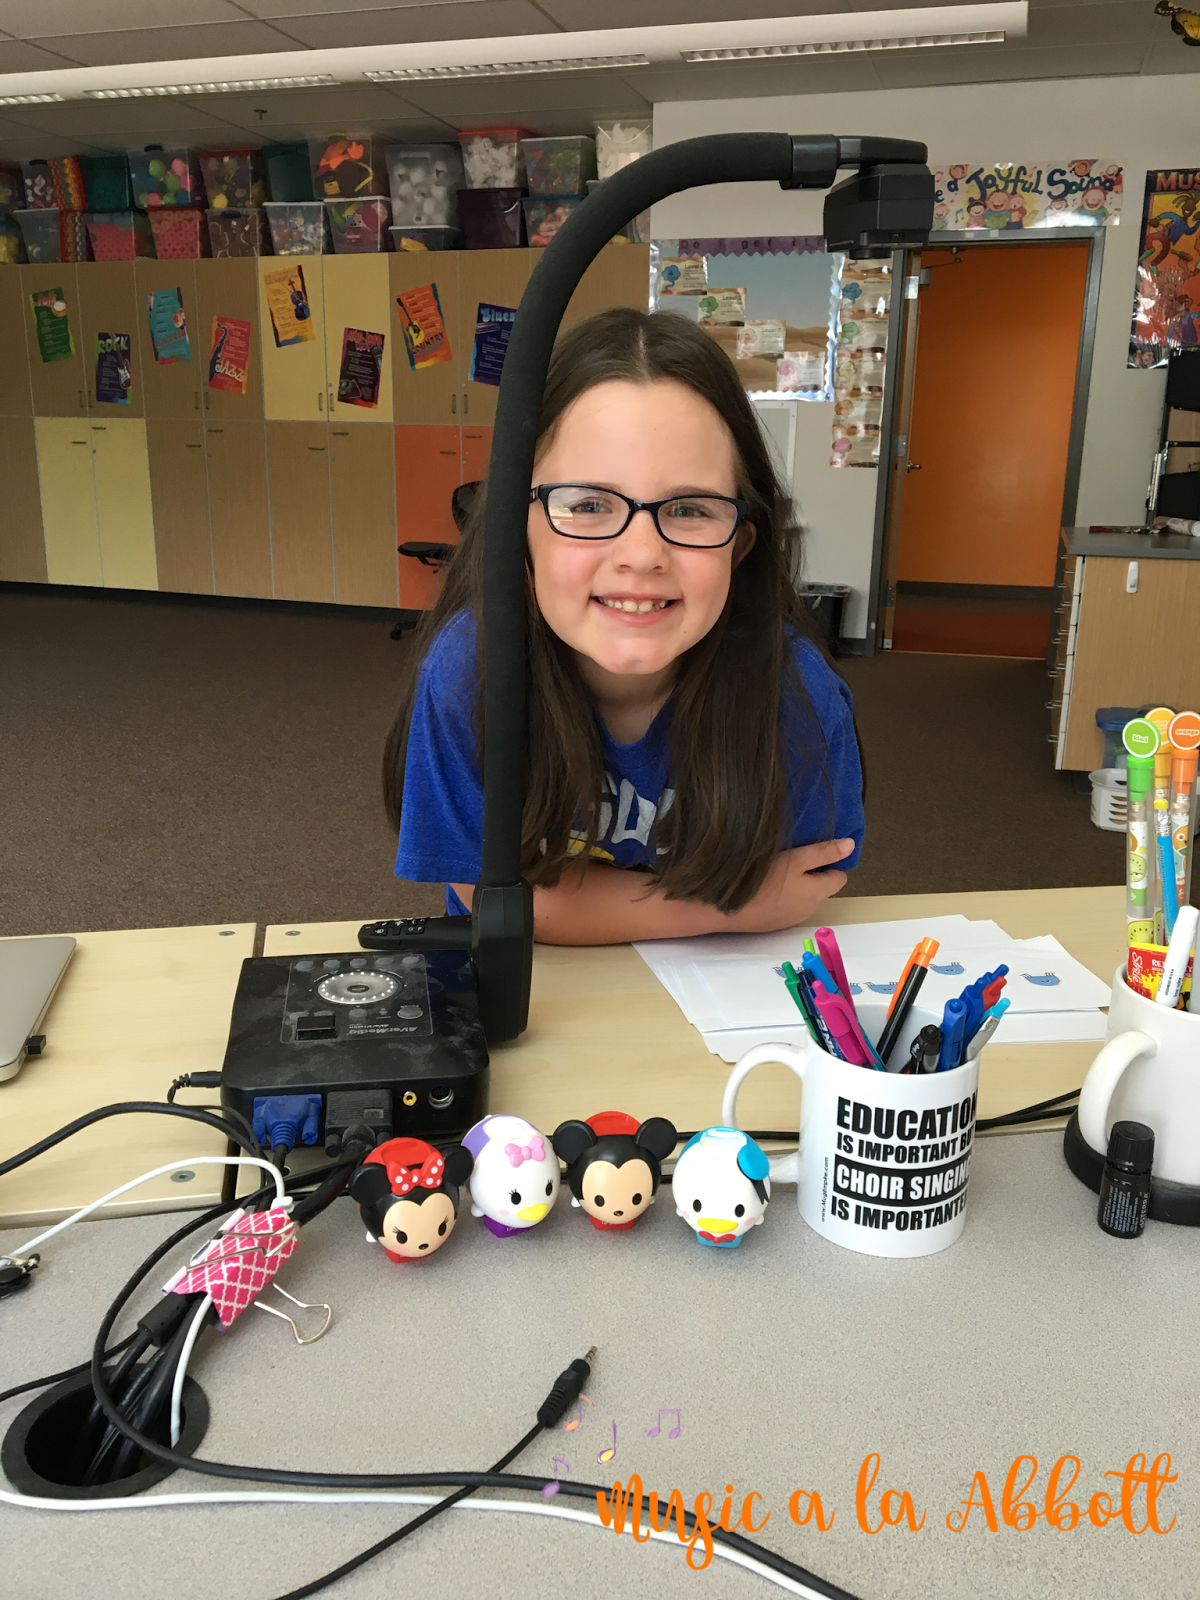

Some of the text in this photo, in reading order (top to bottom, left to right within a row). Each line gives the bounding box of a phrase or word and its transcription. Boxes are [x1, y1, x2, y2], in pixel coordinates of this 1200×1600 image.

[680, 239, 700, 250] Do
[741, 238, 772, 251] get
[480, 307, 516, 323] Blues
[98, 336, 129, 354] ROCK
[1132, 734, 1149, 744] kiwi
[1175, 728, 1200, 737] orange
[1131, 951, 1144, 985] Stride
[836, 1124, 975, 1164] IS IMPORTANT BUT
[836, 1163, 904, 1200] CHOIR
[830, 1194, 850, 1221] IS
